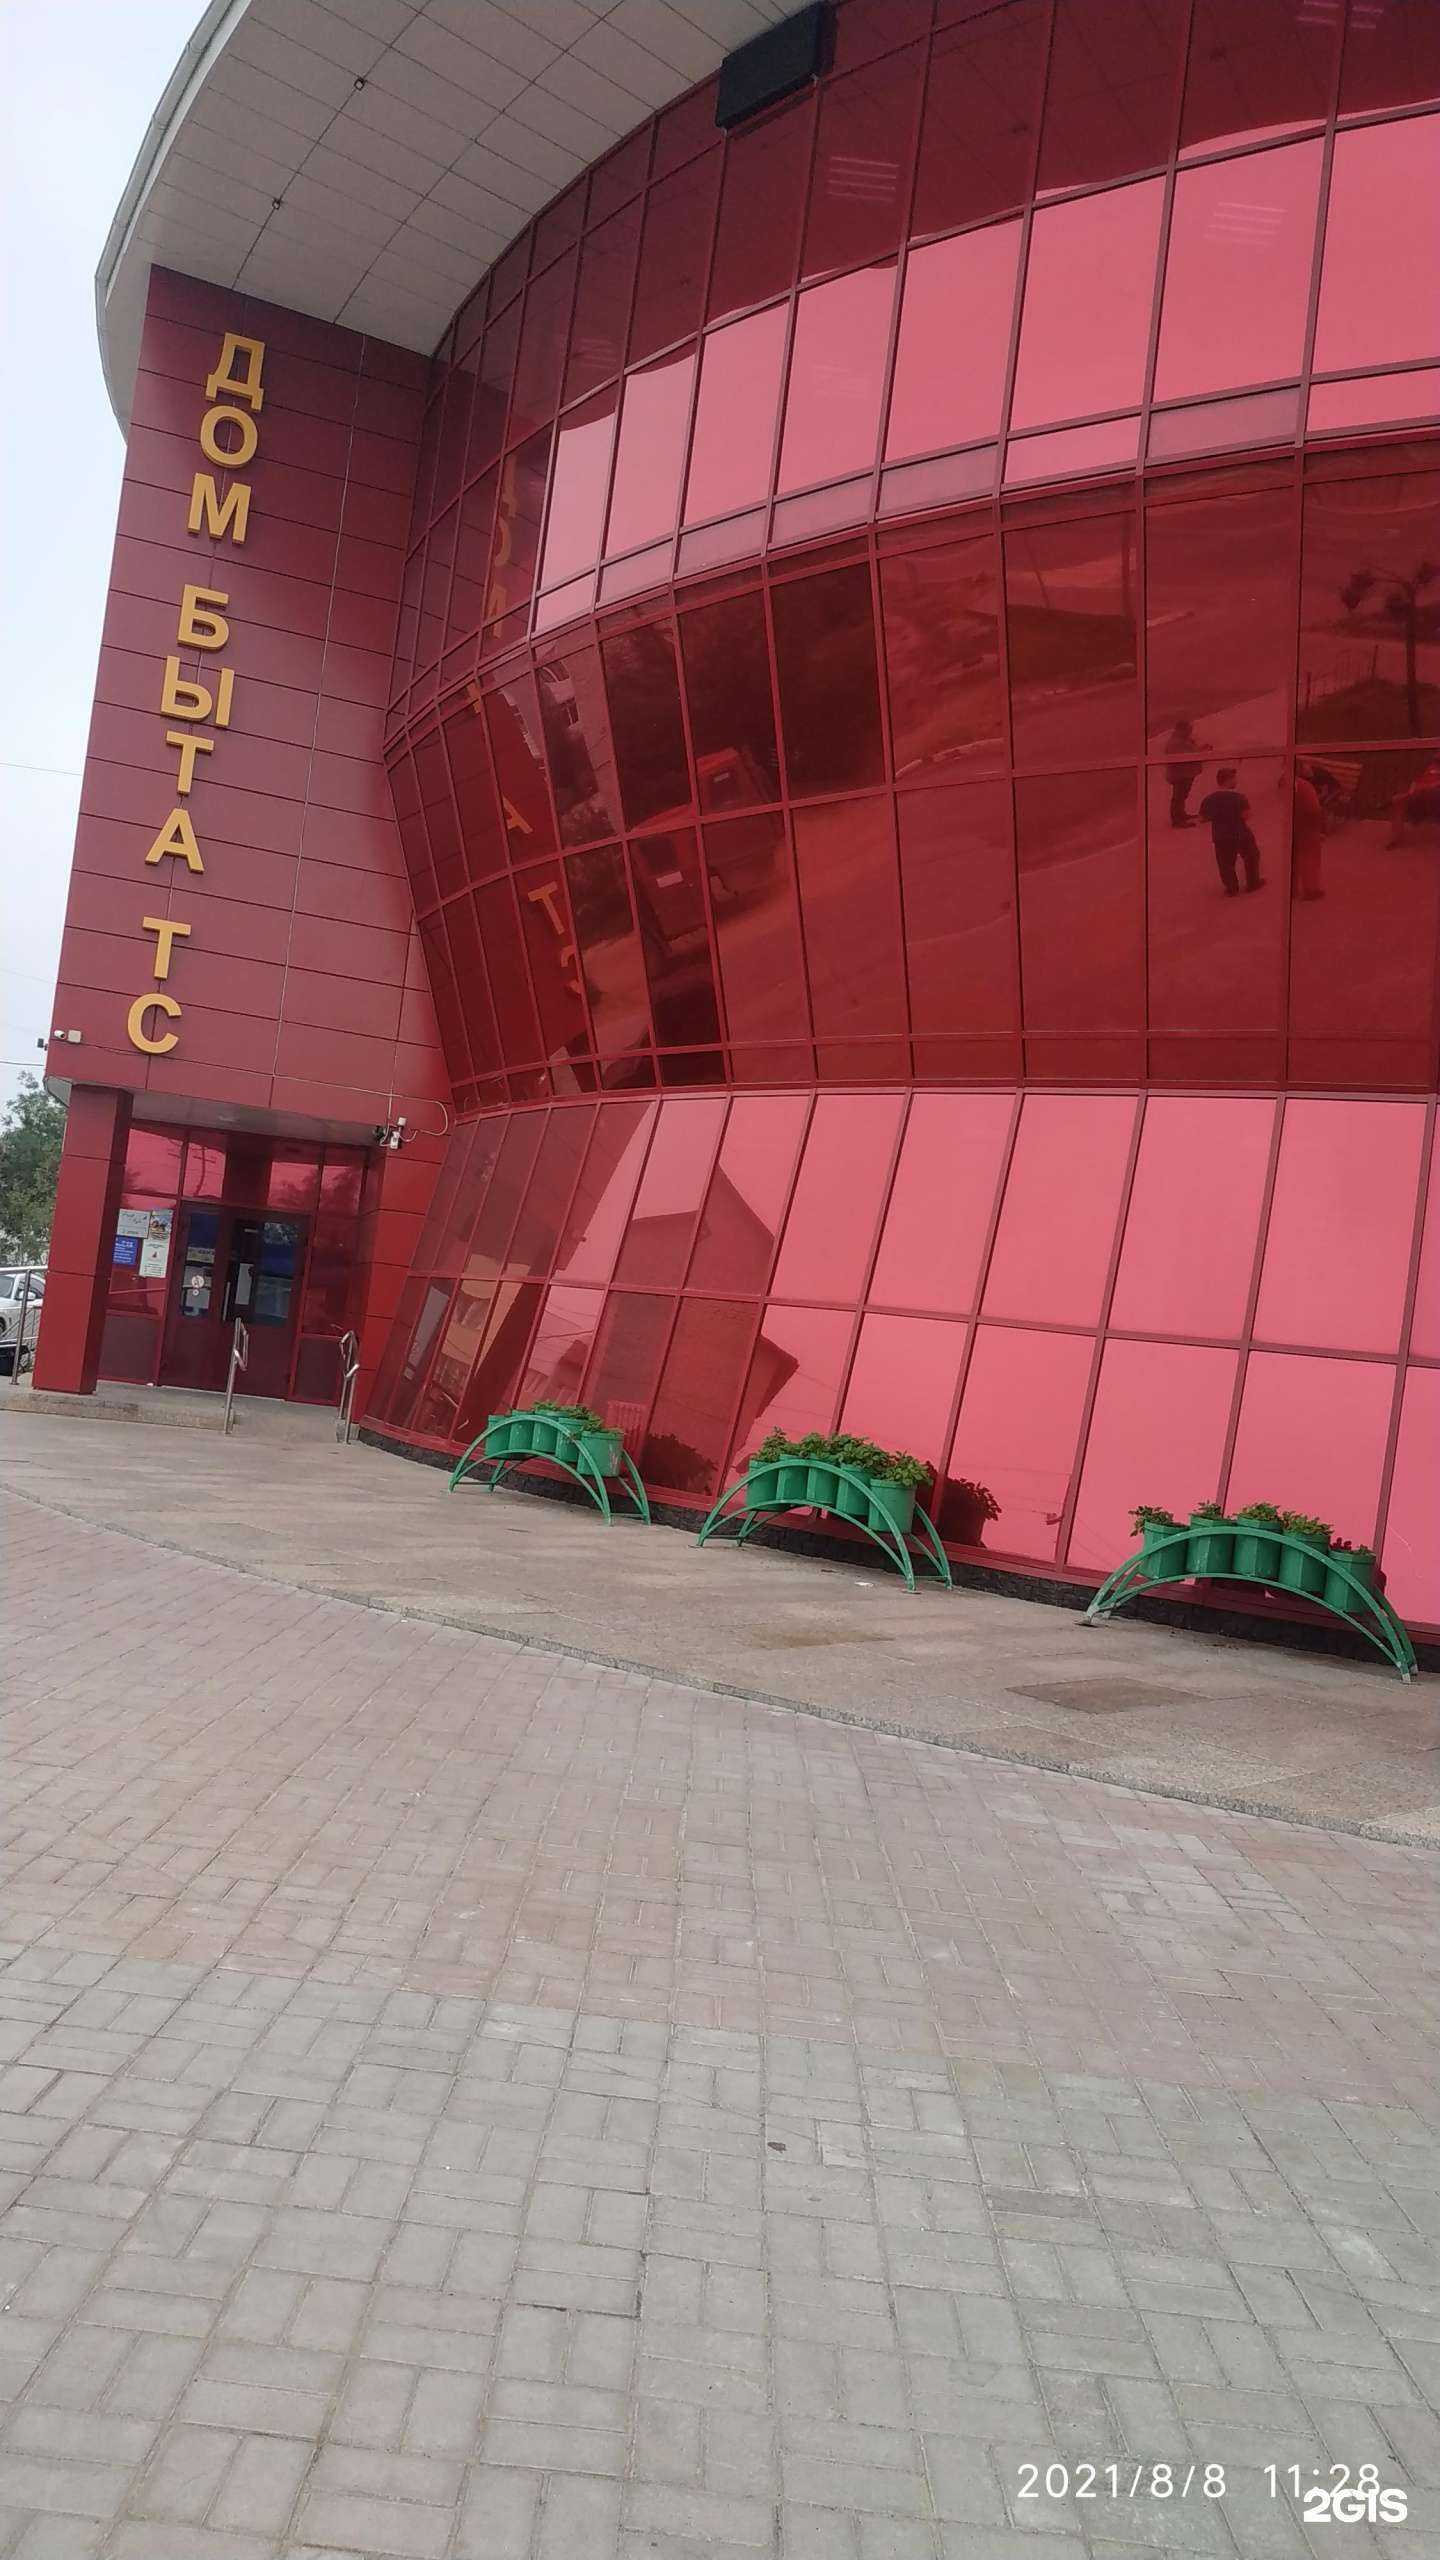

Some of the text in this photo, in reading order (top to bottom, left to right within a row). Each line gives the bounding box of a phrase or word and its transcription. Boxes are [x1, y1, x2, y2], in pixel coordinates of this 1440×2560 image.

[127, 332, 266, 1054] ДОМ БЫТА ТС
